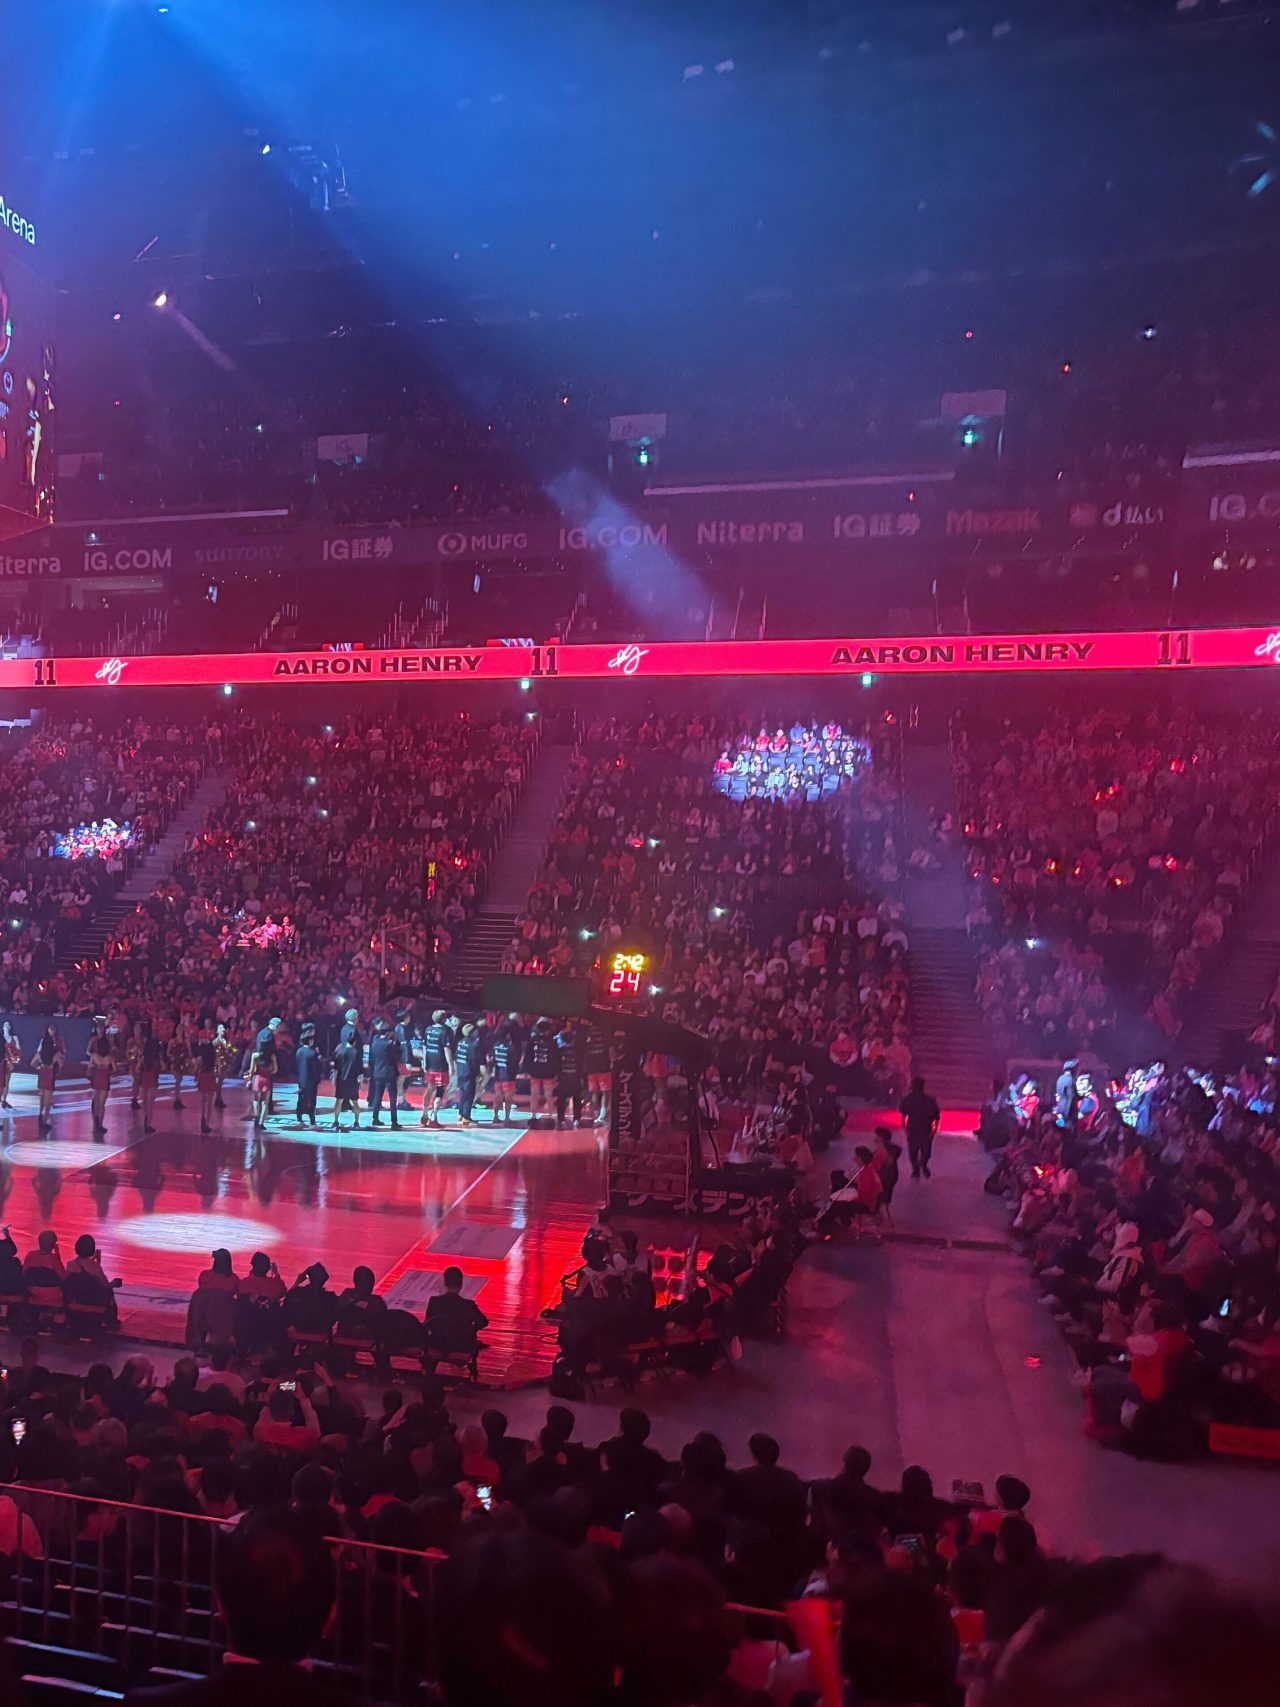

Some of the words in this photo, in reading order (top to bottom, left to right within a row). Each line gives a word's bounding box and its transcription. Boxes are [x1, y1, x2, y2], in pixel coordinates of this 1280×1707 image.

[471, 532, 528, 550] MUFG
[559, 524, 668, 550] IG.COM
[697, 521, 804, 545] Niterra
[0, 555, 61, 575] iterra
[84, 548, 172, 572] IG.COM
[830, 645, 953, 665] AARON
[965, 642, 1096, 661] HENRY
[1156, 632, 1193, 665] 11
[34, 660, 57, 685] 11
[273, 657, 371, 676] AARON
[380, 655, 483, 673] HENRY
[530, 647, 560, 676] 11
[613, 953, 645, 971] 2:42
[610, 970, 641, 992] 24
